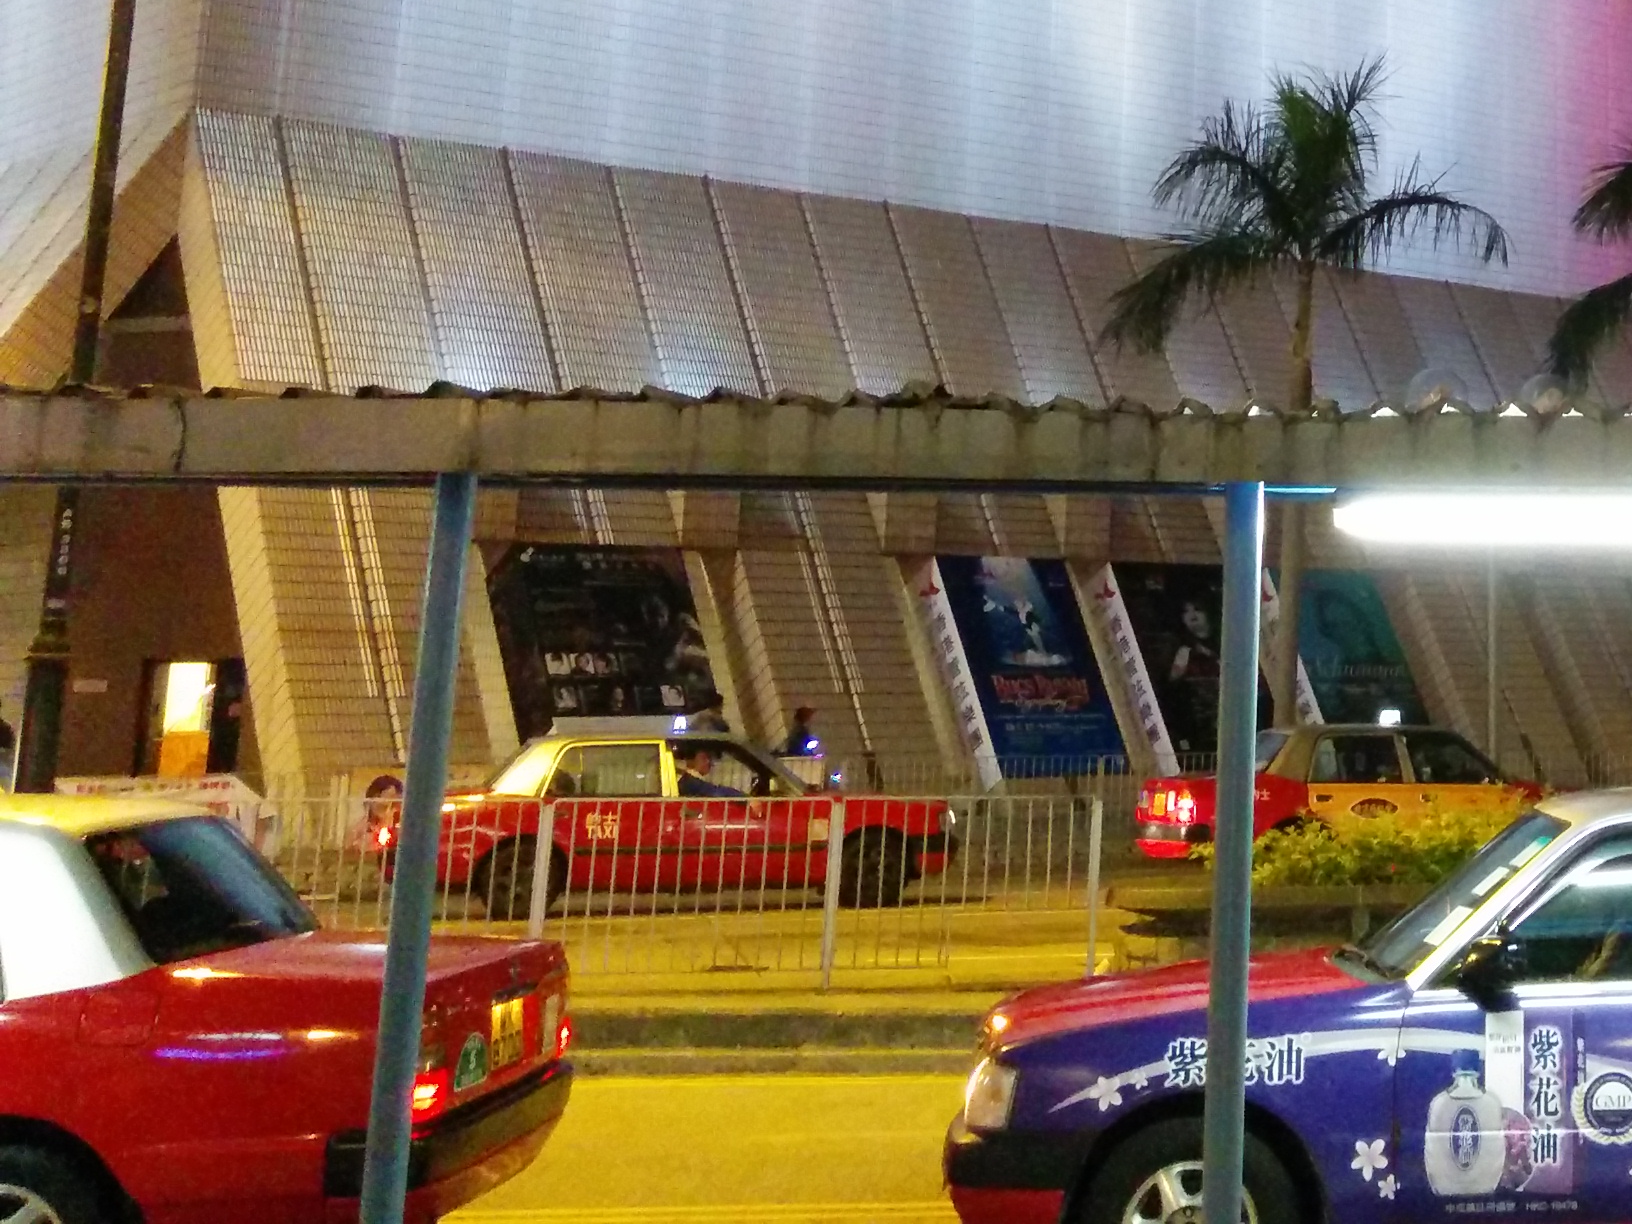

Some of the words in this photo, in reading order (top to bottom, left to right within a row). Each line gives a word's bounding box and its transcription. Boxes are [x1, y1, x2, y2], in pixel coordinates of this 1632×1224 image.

[1531, 1027, 1560, 1165] 紫花油
[1595, 1094, 1632, 1110] GMP
